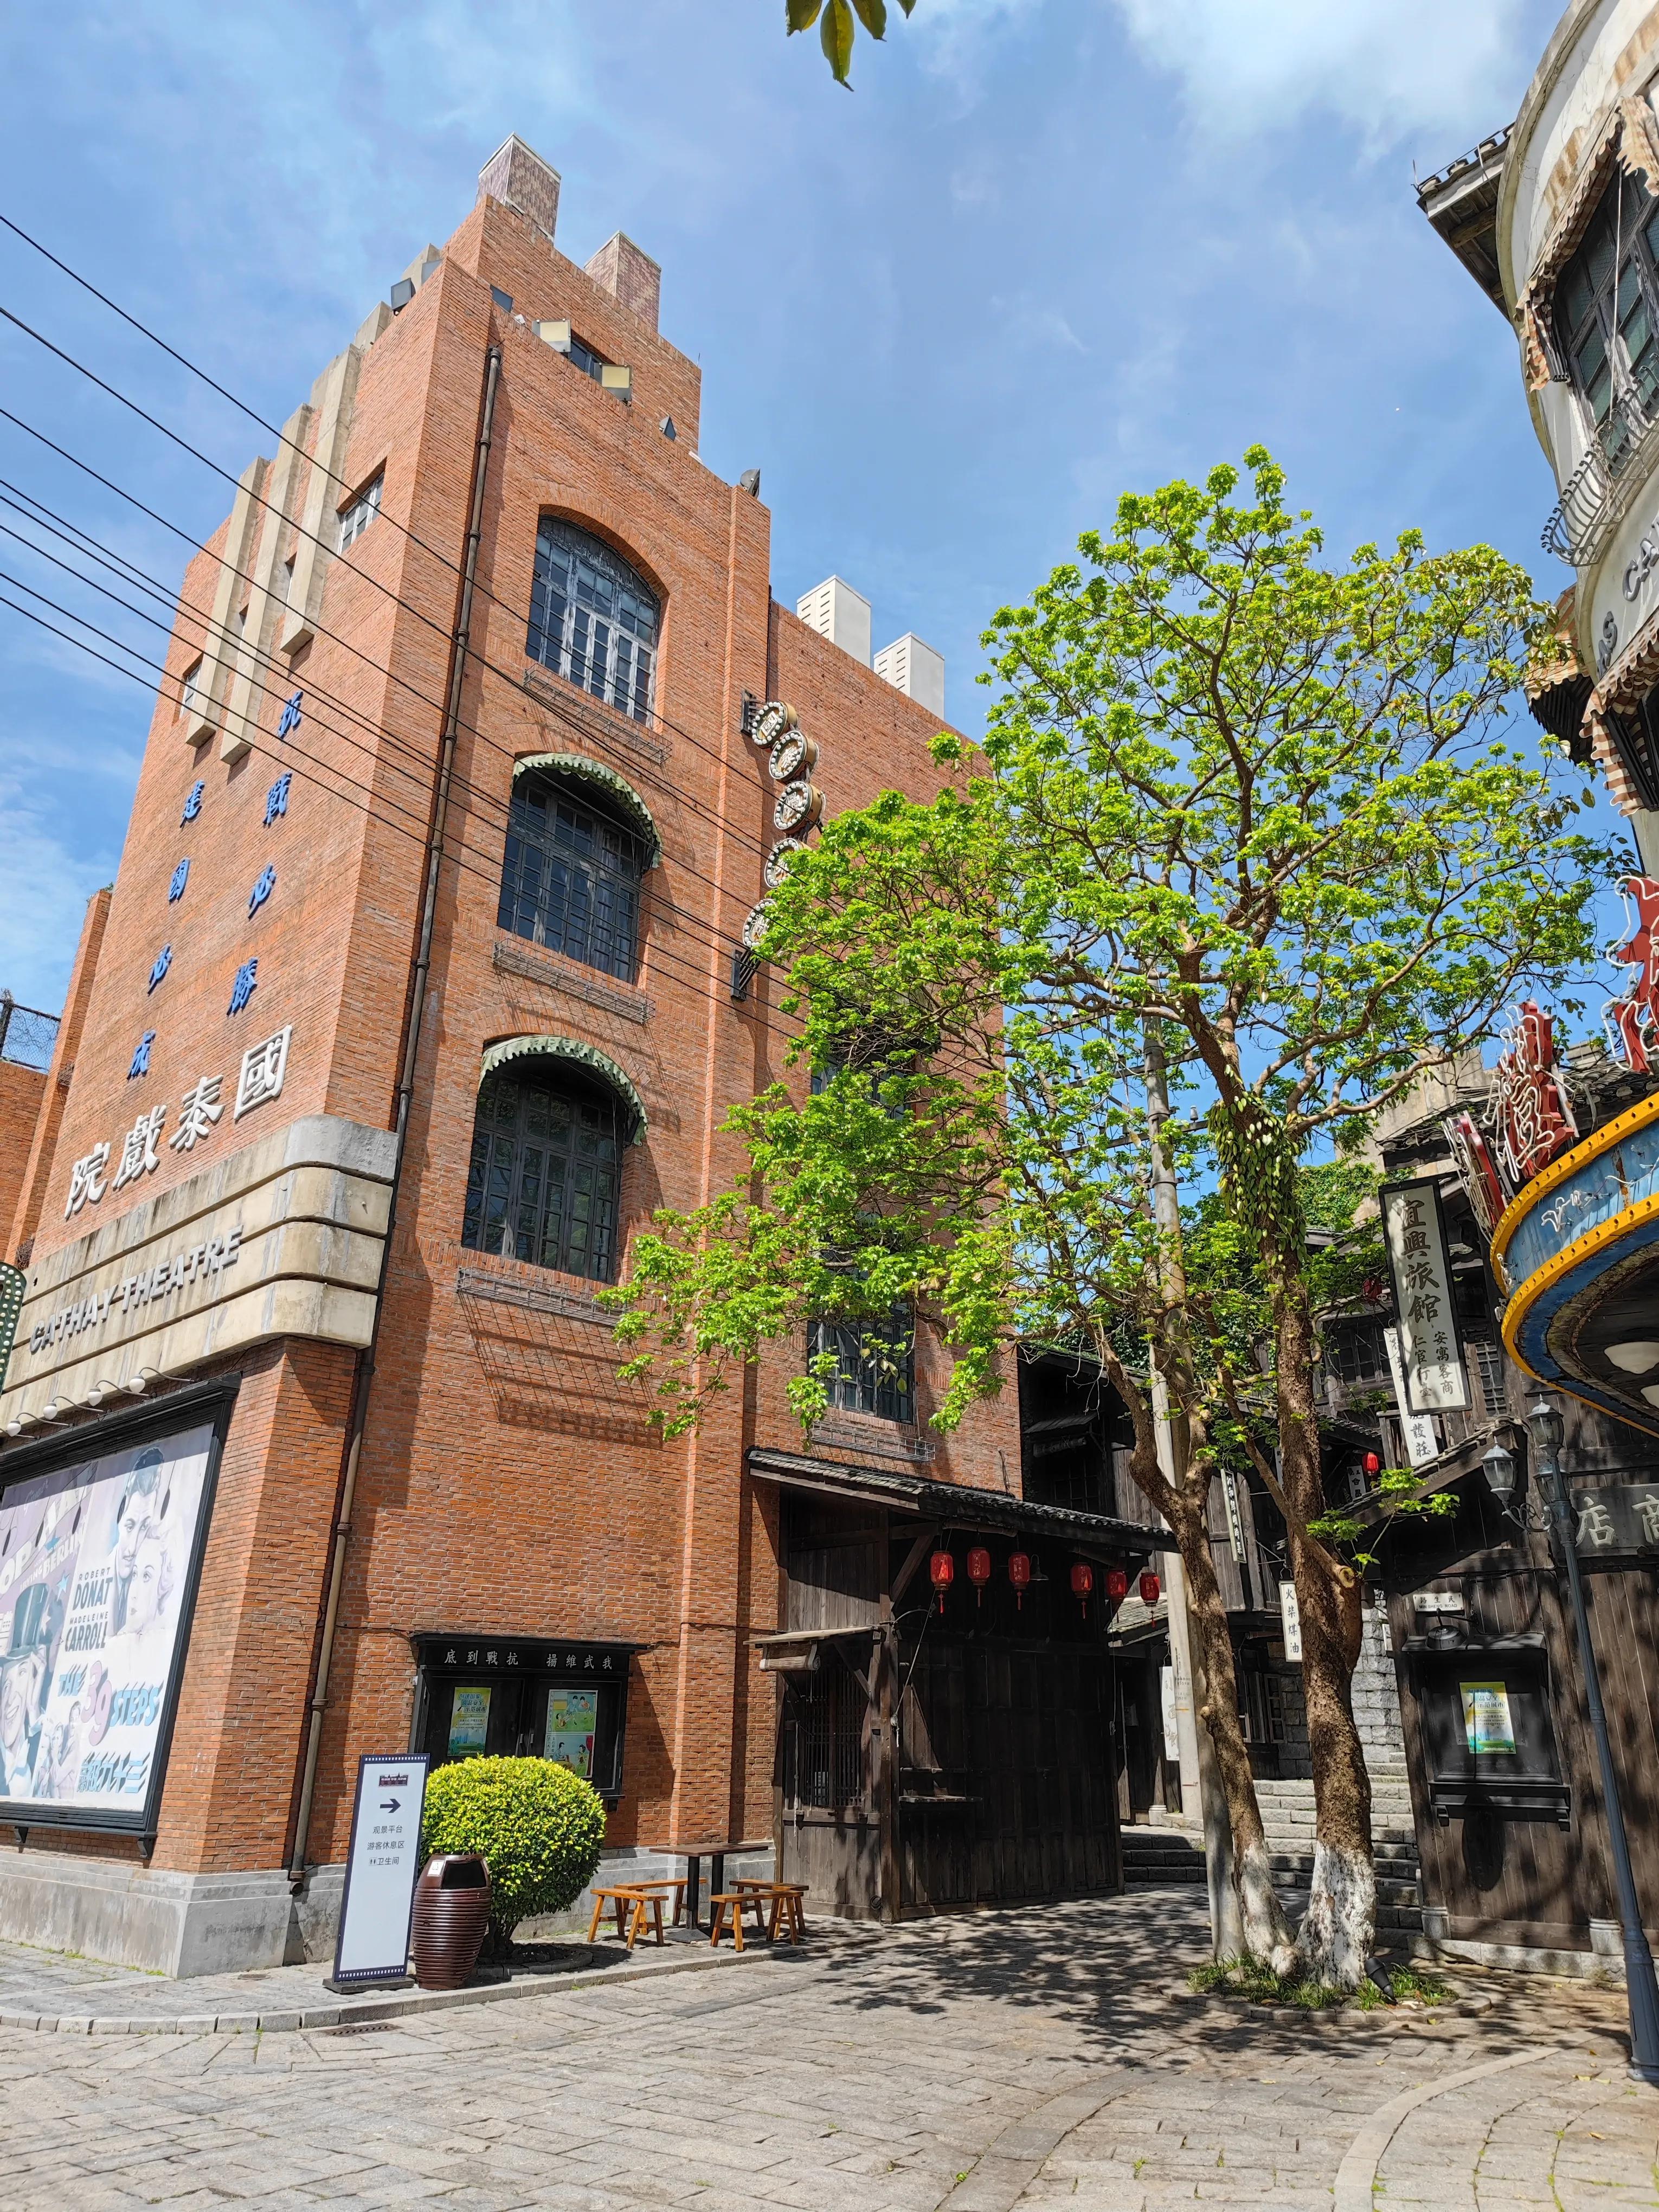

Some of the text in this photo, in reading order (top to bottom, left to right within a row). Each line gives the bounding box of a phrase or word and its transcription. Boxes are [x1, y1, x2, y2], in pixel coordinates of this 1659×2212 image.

[1399, 1199, 1442, 1324] 宜興旅館
[29, 1224, 245, 1353] CATHAY THEATRE
[78, 1567, 111, 1581] ROBERT
[72, 1577, 113, 1611] DONAT
[69, 1611, 108, 1625] MADELEINE
[1285, 1588, 1300, 1654] 火柴煤油
[65, 1621, 108, 1652] CARROLL
[57, 1660, 160, 1747] THE 39 STEPS
[372, 1825, 403, 1834] 观景平台
[366, 1841, 405, 1850] 游客休息区
[377, 1856, 400, 1866] 卫生间
